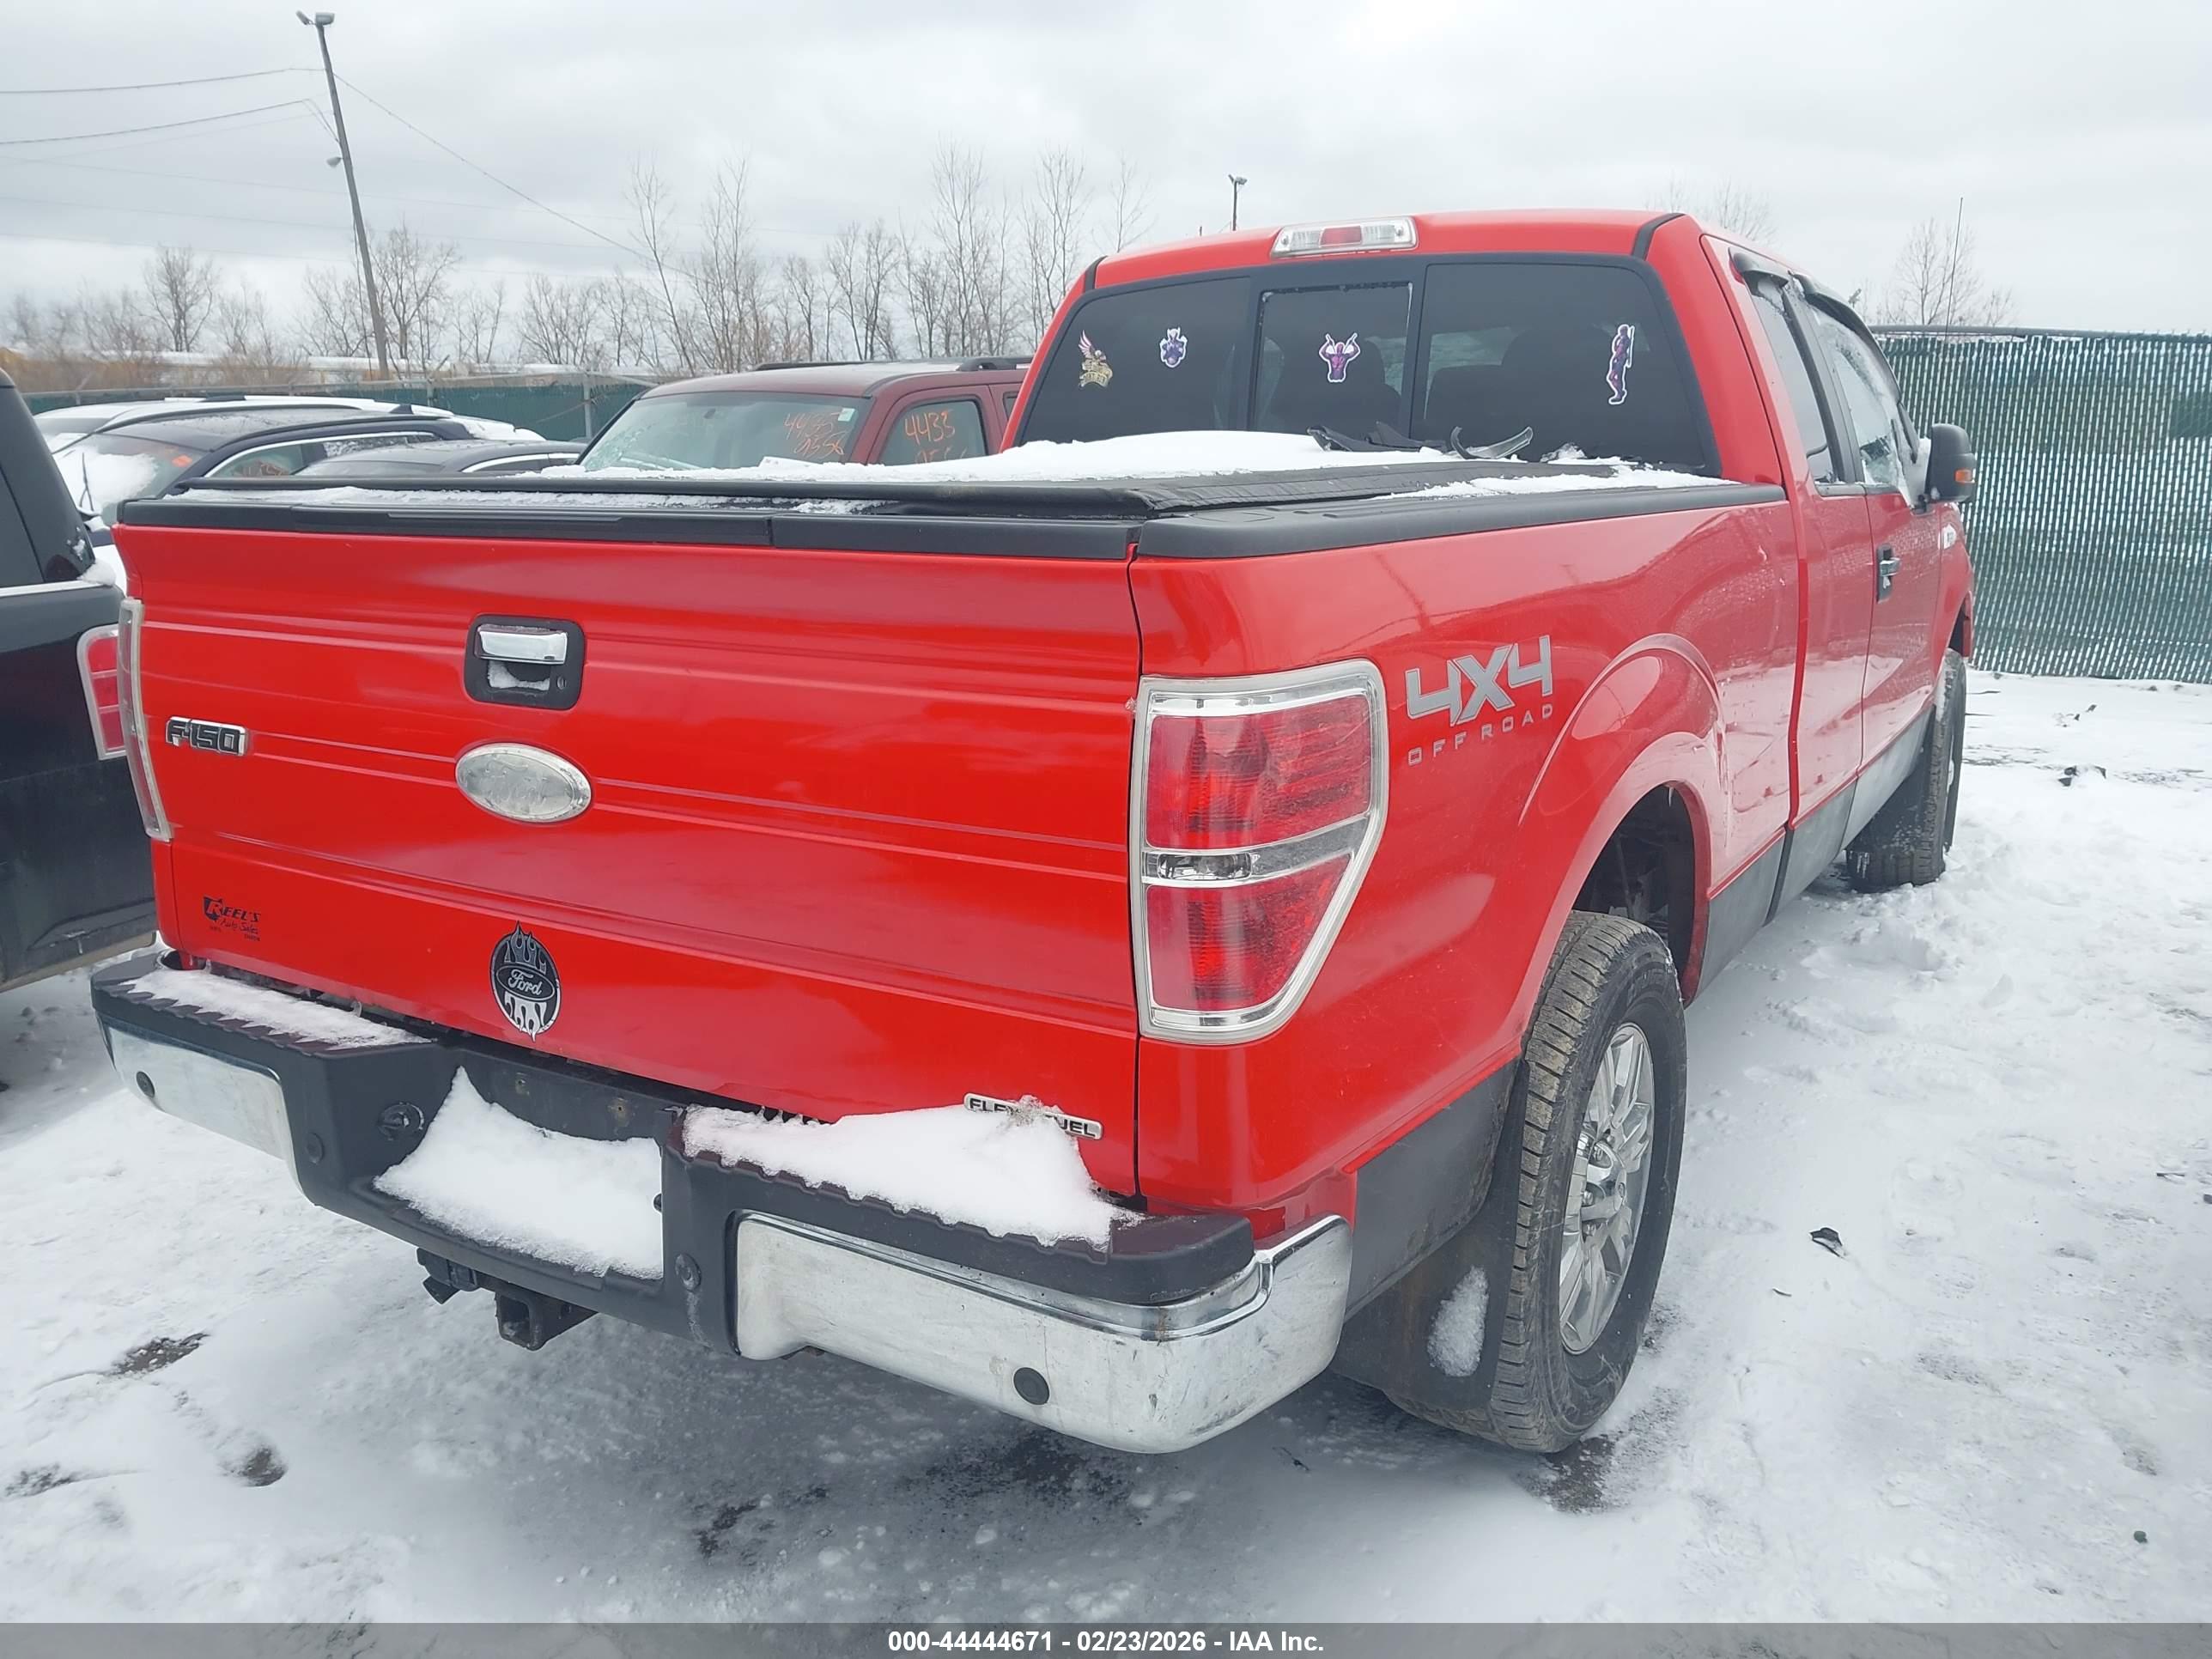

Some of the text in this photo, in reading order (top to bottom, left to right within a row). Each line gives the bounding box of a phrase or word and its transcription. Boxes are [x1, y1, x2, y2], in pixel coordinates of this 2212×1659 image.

[1405, 635, 1553, 726] 4X4
[1407, 703, 1553, 766] OFF ROAD
[507, 969, 543, 996] Ford
[1044, 1113, 1097, 1138] UEL
